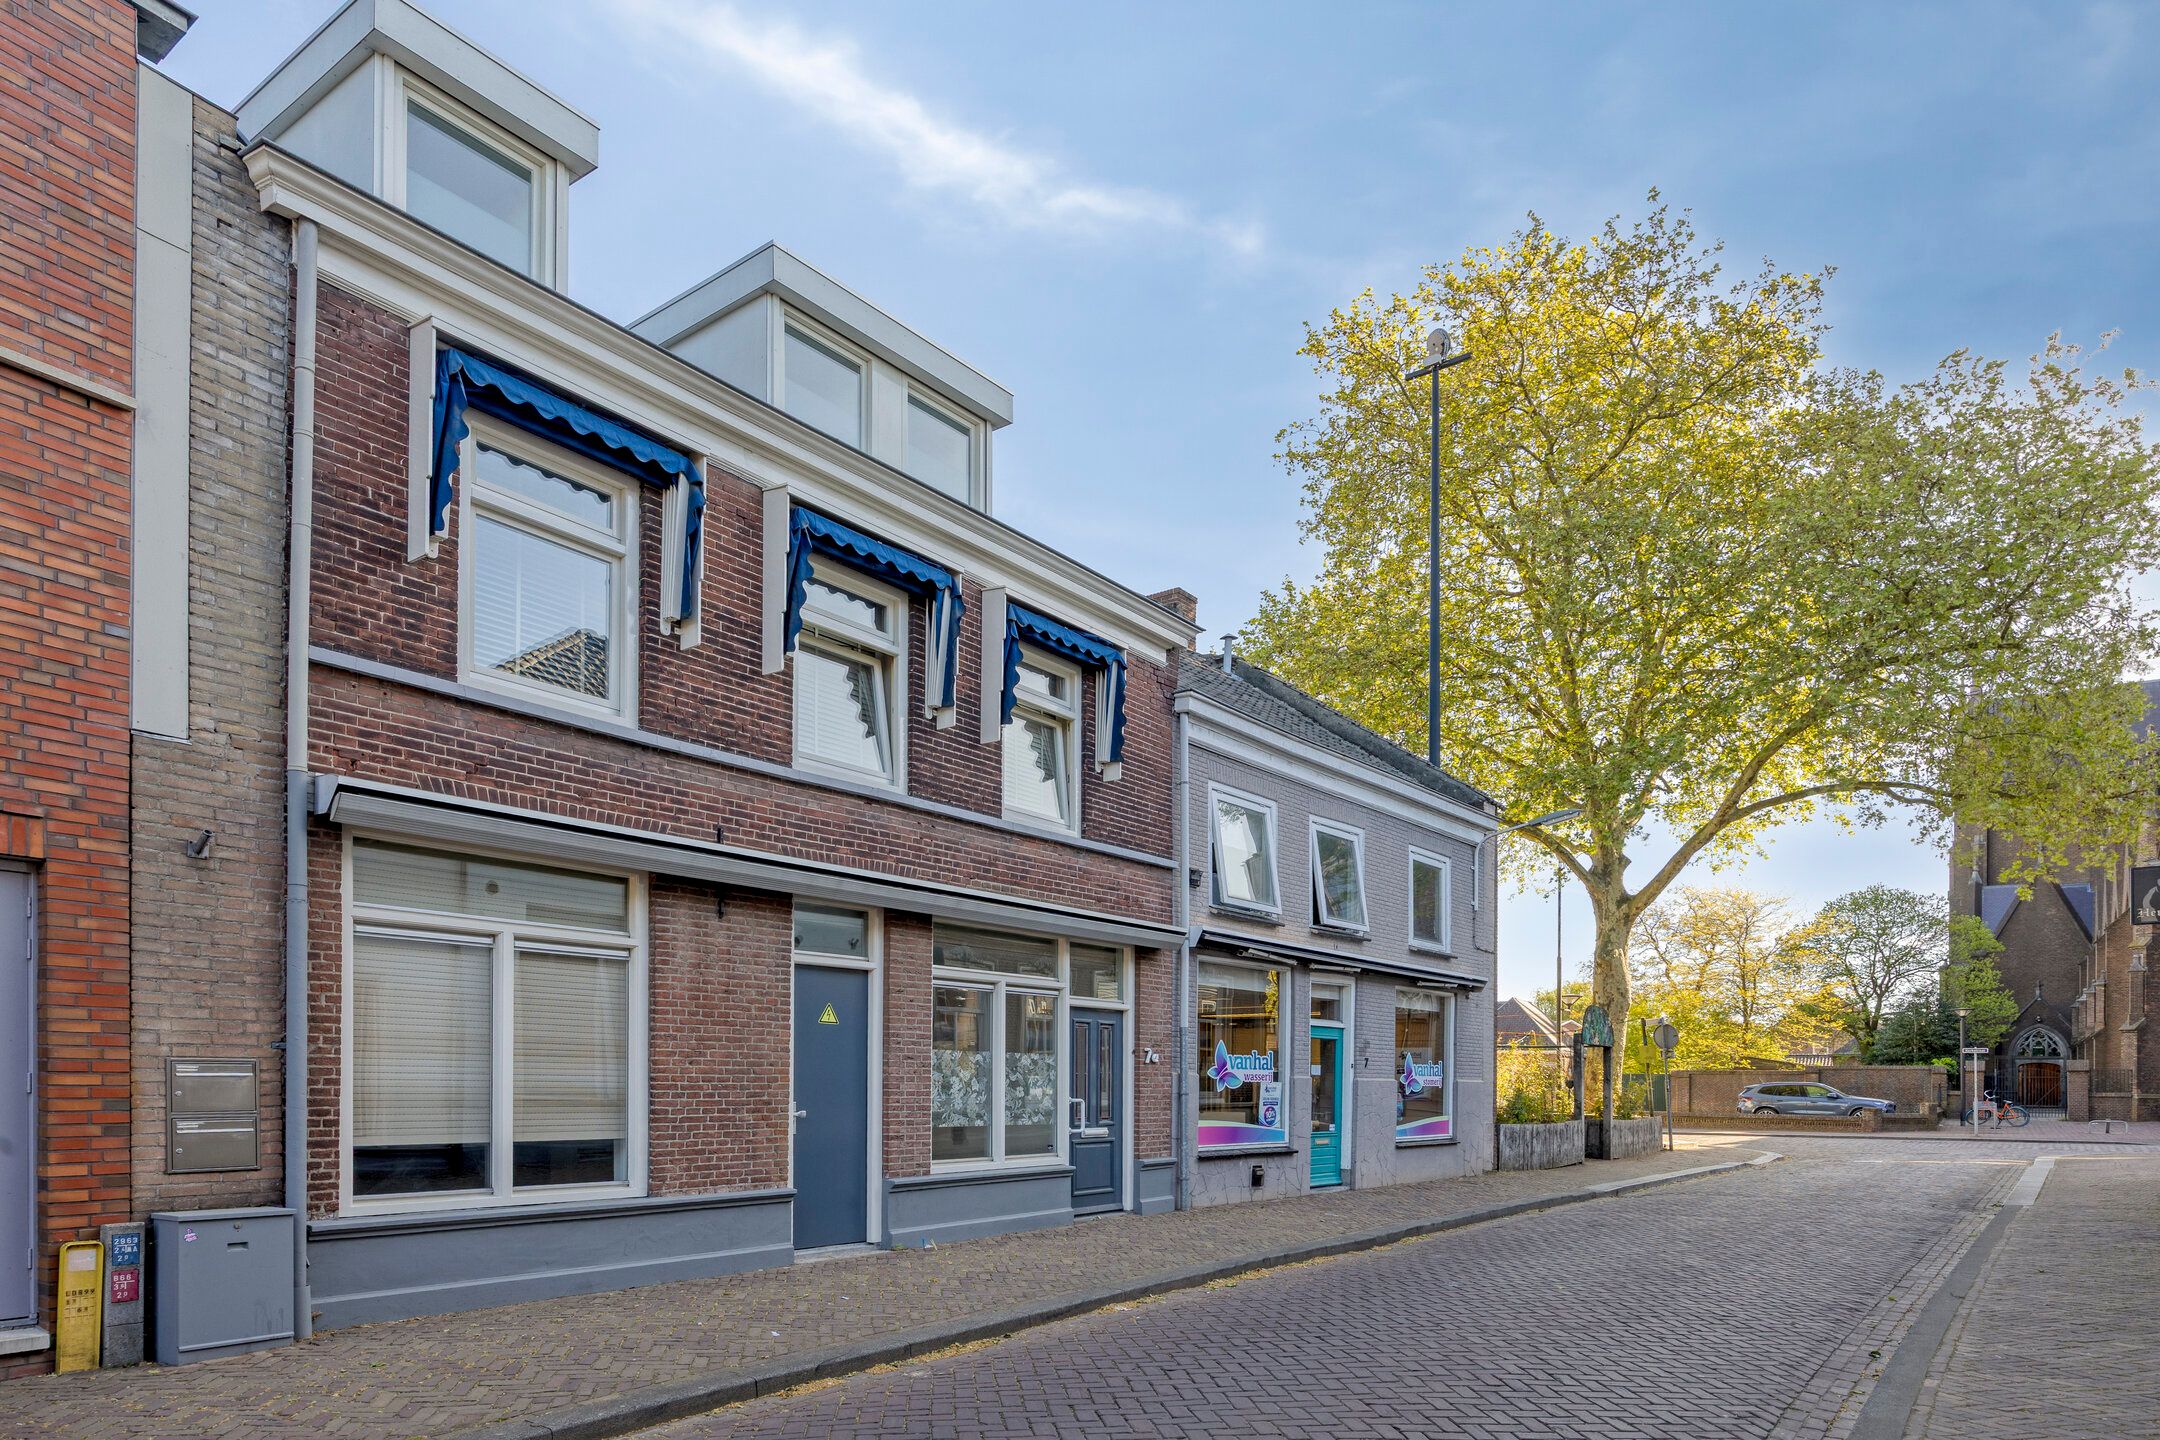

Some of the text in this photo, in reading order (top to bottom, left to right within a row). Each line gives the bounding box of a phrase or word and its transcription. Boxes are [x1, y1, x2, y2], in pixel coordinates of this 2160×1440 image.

[1144, 1048, 1159, 1063] 7a
[1228, 1051, 1273, 1070] vanhal
[1364, 1058, 1369, 1068] 7
[1414, 1061, 1443, 1077] vanhal
[1244, 1072, 1273, 1083] wasserij
[1423, 1078, 1442, 1087] stomerij
[114, 1237, 138, 1245] 2863
